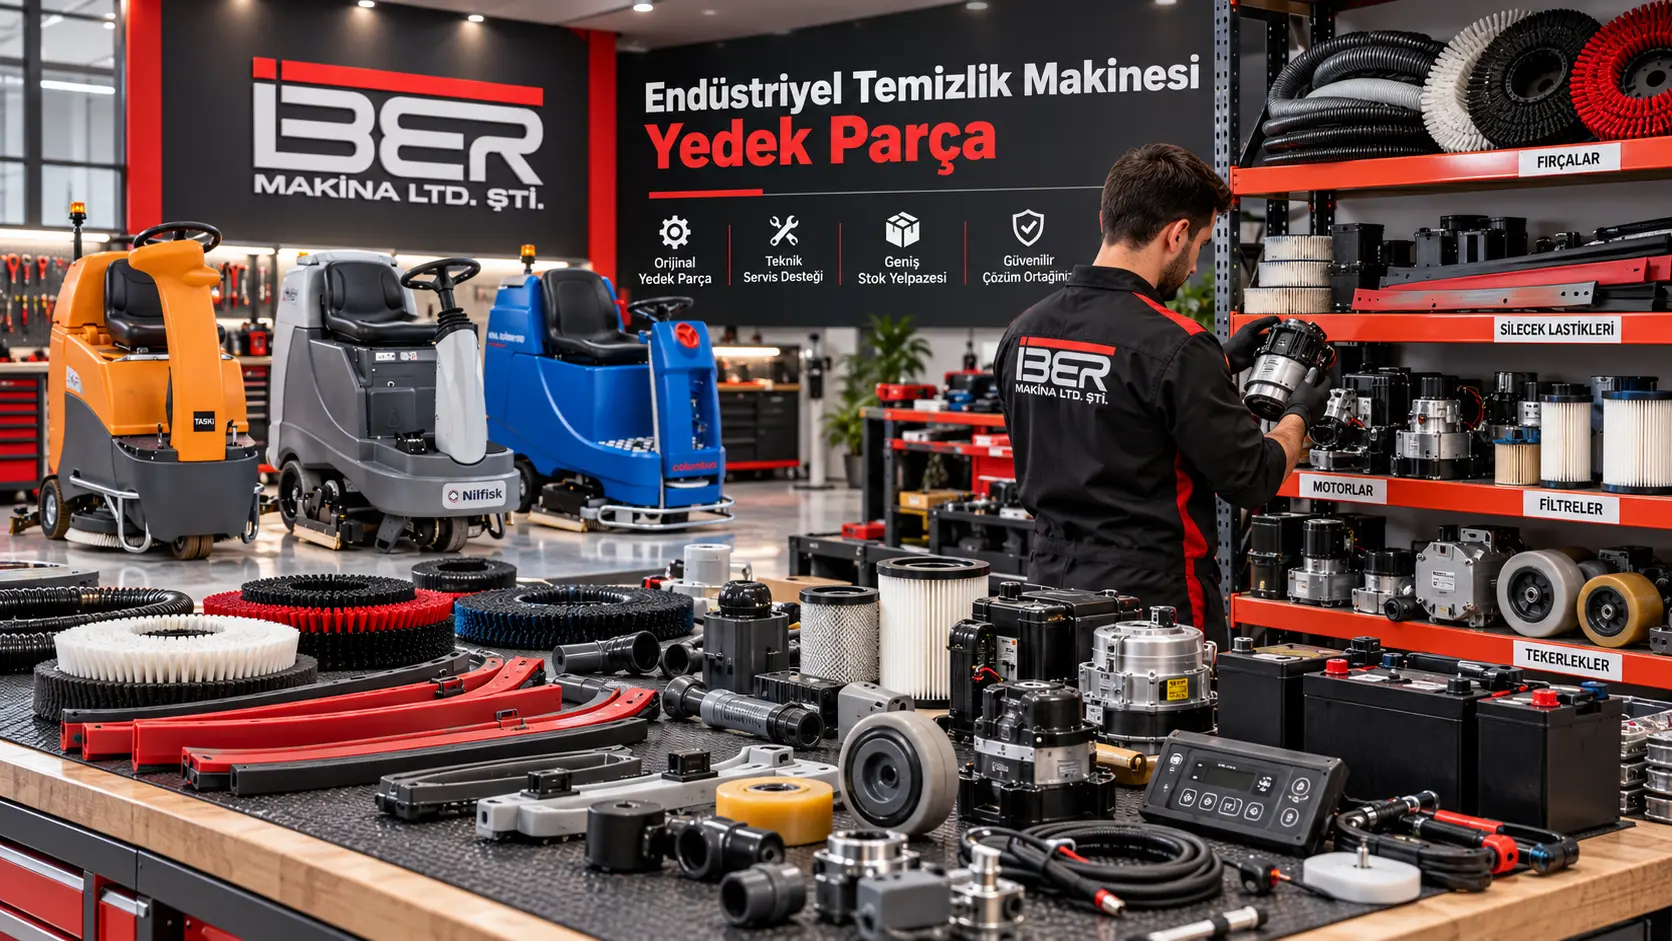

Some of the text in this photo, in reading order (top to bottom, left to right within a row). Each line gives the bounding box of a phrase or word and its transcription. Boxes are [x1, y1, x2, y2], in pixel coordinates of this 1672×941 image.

[645, 54, 1200, 115] Endüstriyel Temizlik Makinesi
[644, 114, 996, 176] Yedek Parça
[1537, 151, 1601, 171] FIRÇALAR
[253, 173, 545, 212] MAKİNA LTD. ŞTİ.
[654, 256, 696, 271] Orijinal
[765, 254, 803, 267] Teknik
[884, 255, 920, 270] Geniş
[1003, 253, 1055, 267] Güvenilir
[638, 272, 712, 287] Yedek Parça
[743, 270, 824, 284] Servis Desteği
[858, 271, 947, 287] Stok Yelpazesi
[982, 271, 1021, 286] Çözüm
[1500, 320, 1614, 336] SİLECEK LASTİKLERİ
[1015, 383, 1108, 405] MAKİNA LTD. ŞTİ.
[462, 488, 503, 501] Nilfisk
[1312, 480, 1374, 497] MOTORLAR
[1539, 495, 1604, 516] FİLTRELER
[1525, 648, 1610, 672] TEKERLEKLER
